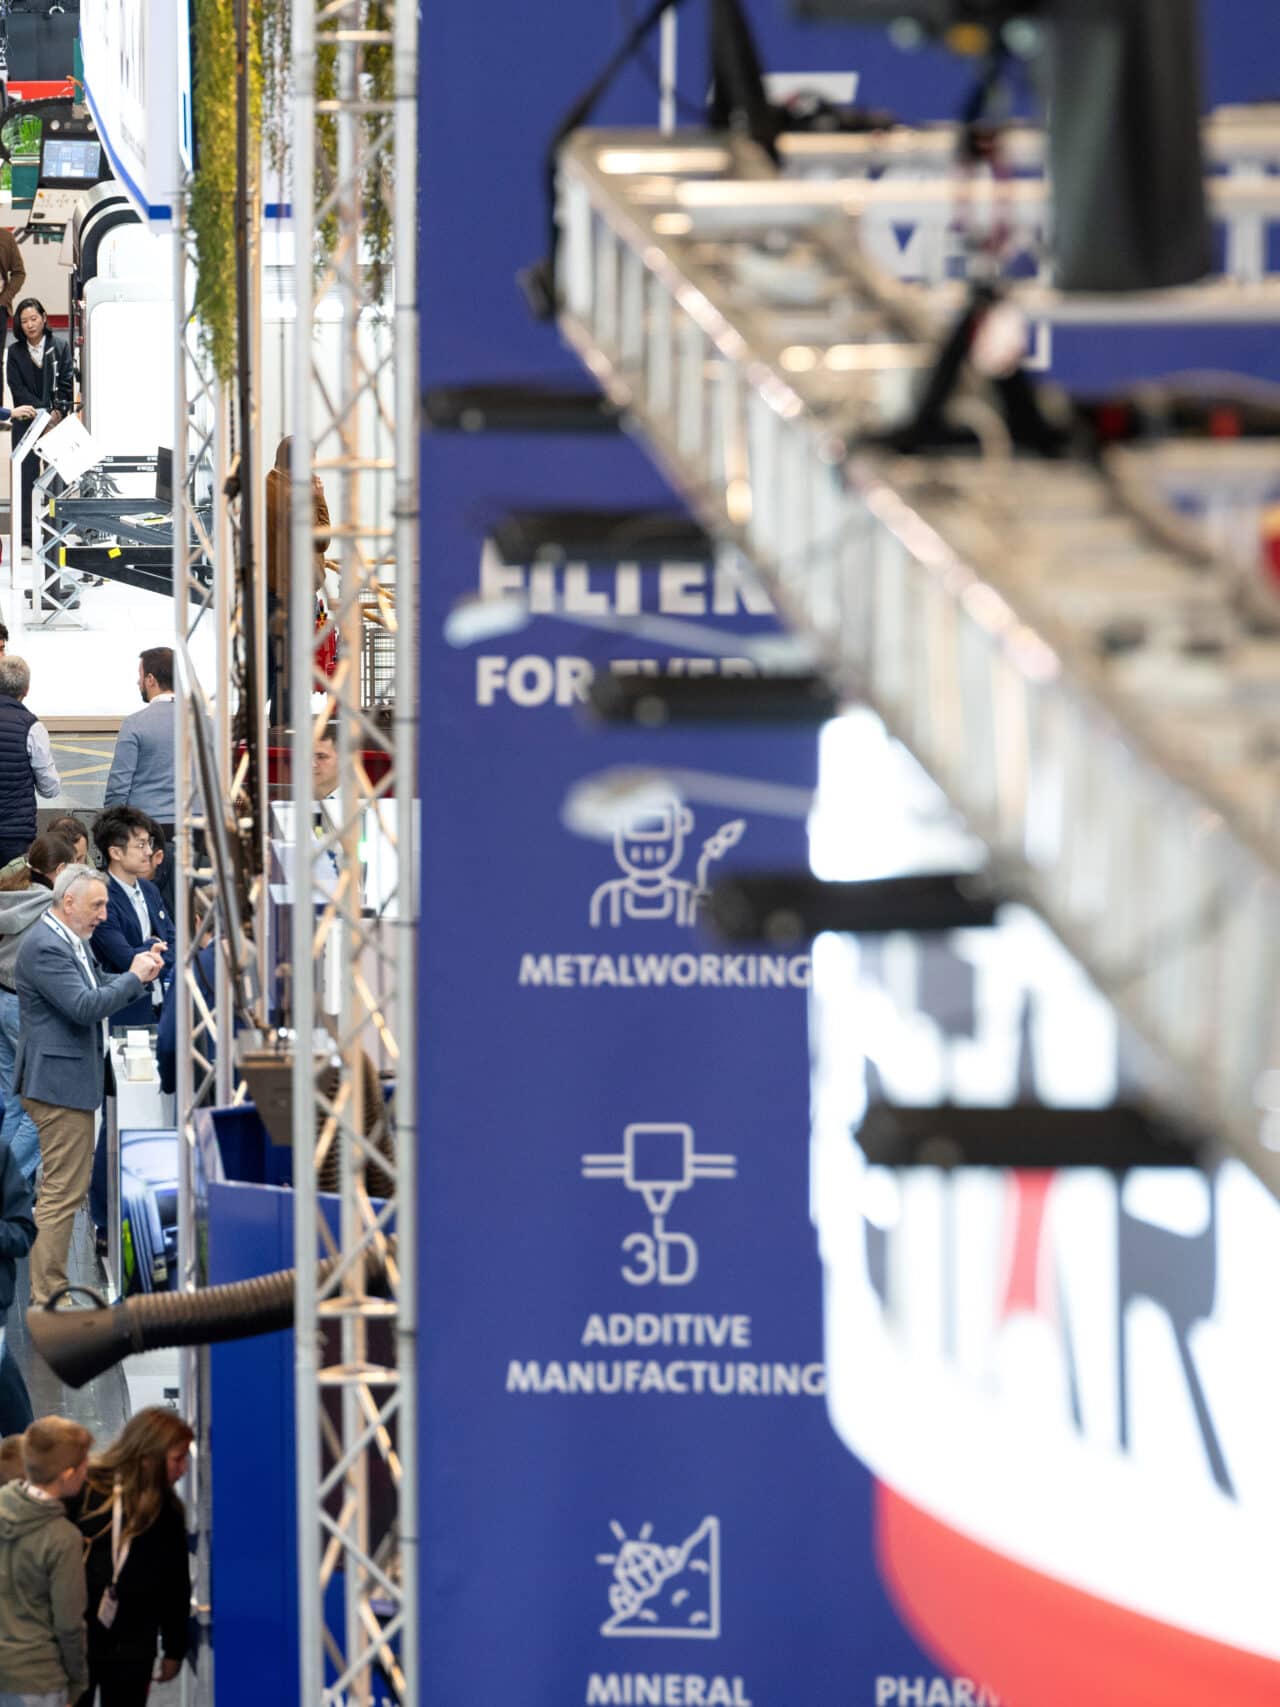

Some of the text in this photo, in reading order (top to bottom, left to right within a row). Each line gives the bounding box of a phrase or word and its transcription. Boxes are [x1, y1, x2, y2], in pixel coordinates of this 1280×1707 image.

[476, 656, 595, 707] FOR
[519, 953, 811, 987] METALWORKING
[581, 1314, 752, 1348] ADDITIVE
[506, 1360, 826, 1396] MANUFACTURING
[586, 1674, 752, 1707] MINERAL
